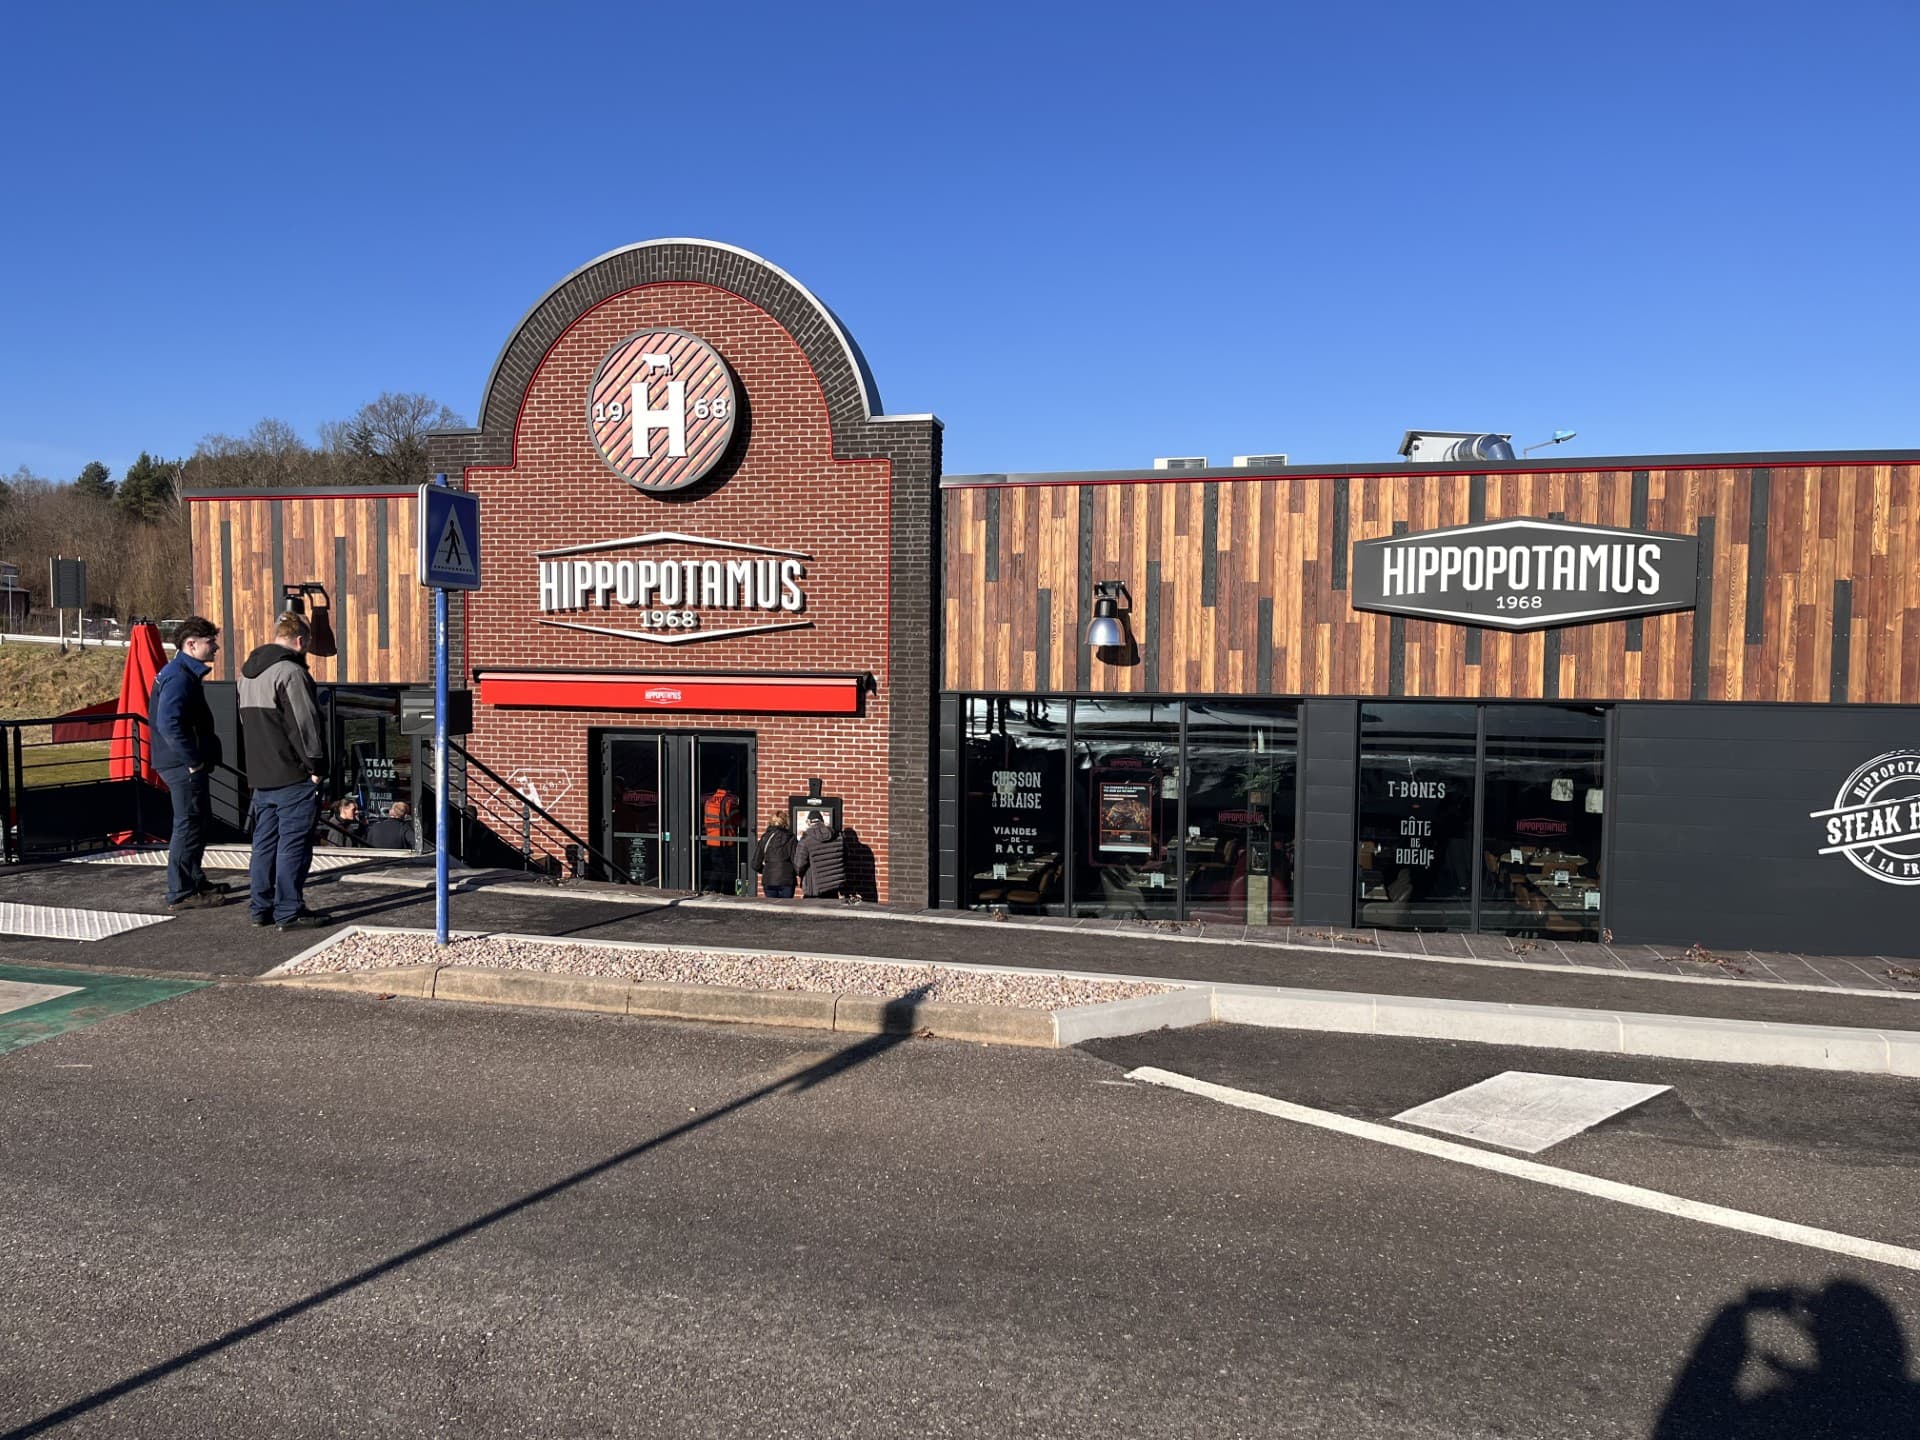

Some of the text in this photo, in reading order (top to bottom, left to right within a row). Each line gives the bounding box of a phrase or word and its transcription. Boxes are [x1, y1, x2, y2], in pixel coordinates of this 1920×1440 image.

[595, 380, 727, 459] 19 H 68
[1382, 543, 1661, 596] HIPPOPOTAMUS
[539, 559, 803, 611] HIPPOPOTAMUS
[1496, 596, 1543, 609] 1968
[639, 610, 696, 629] 1968
[364, 758, 395, 768] TEAK
[366, 769, 396, 779] OUSE
[991, 770, 1042, 788] CUISSON
[1387, 780, 1446, 799] T-BONES
[1000, 792, 1042, 809] BRAISE
[993, 826, 1038, 836] VIANDES
[1400, 815, 1432, 836] CÔTE
[1826, 806, 1901, 846] STEAK
[995, 844, 1035, 855] RACE
[1395, 848, 1435, 869] BOEUF
[1878, 858, 1894, 874] LA
